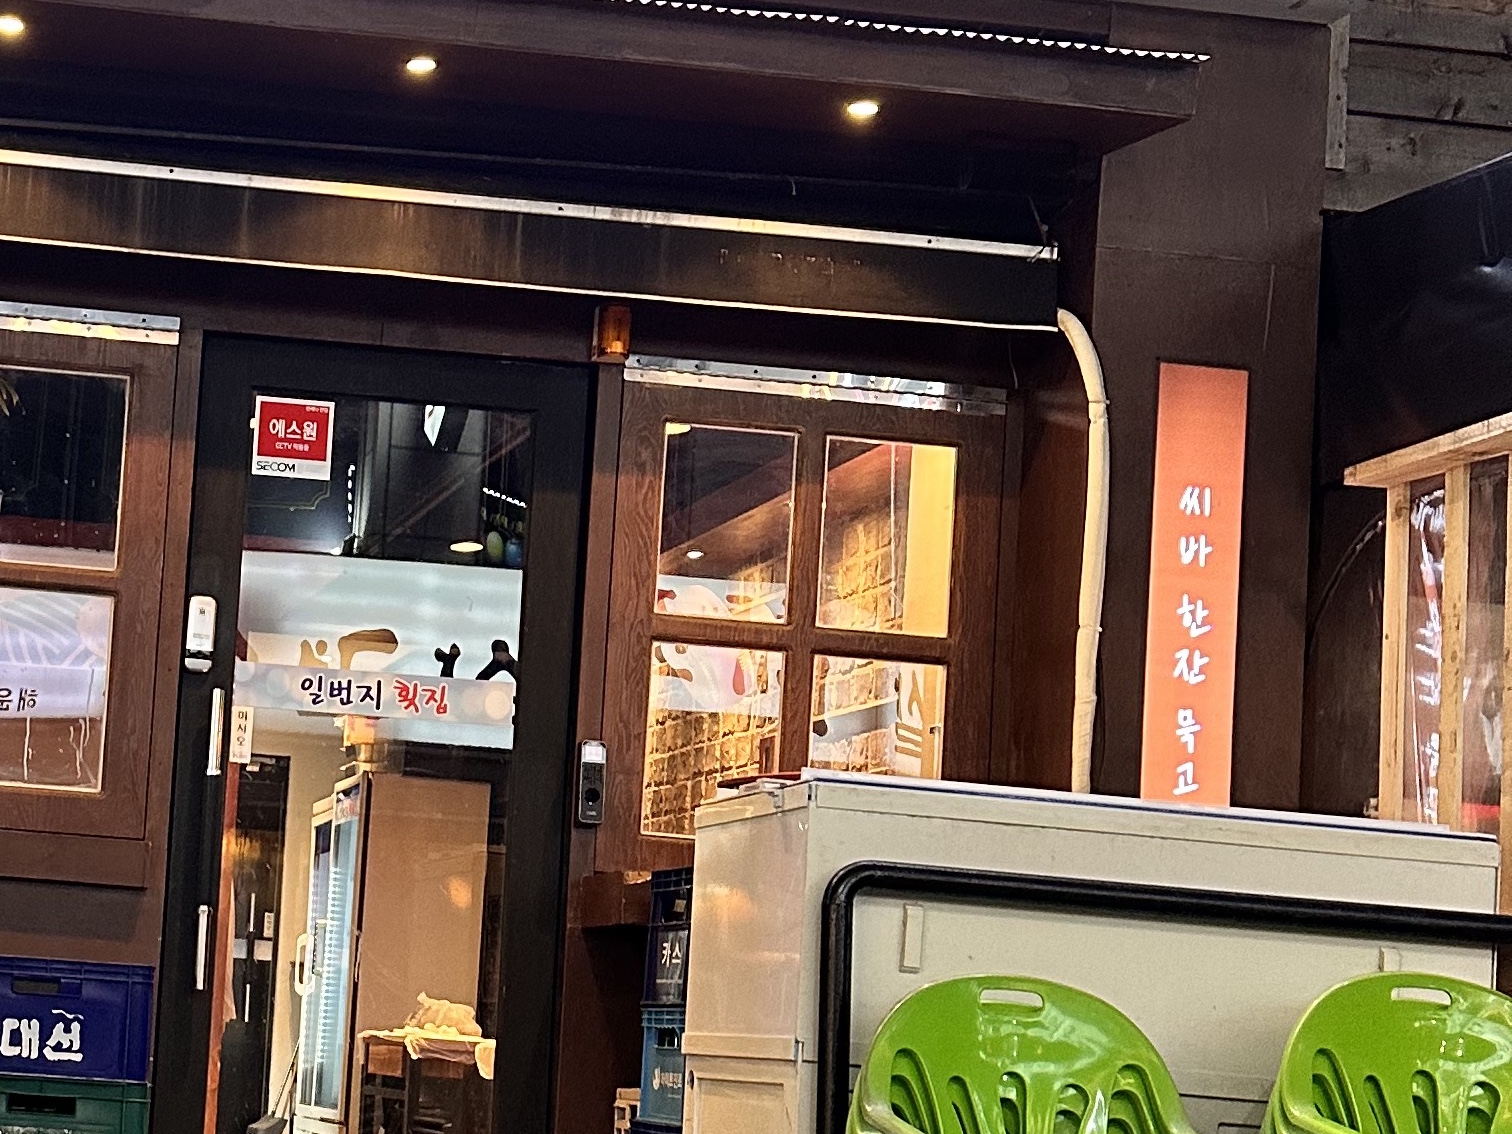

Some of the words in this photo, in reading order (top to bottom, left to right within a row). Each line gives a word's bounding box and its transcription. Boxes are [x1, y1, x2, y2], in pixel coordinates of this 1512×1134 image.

[269, 419, 317, 441] 에스원
[1179, 486, 1213, 568] 씨바
[1173, 593, 1213, 686] 한잔
[300, 675, 382, 711] 일번지
[393, 679, 448, 715] 횟집
[1173, 708, 1201, 796] 묵고
[661, 941, 683, 968] 카스
[0, 1010, 85, 1062] 대선
